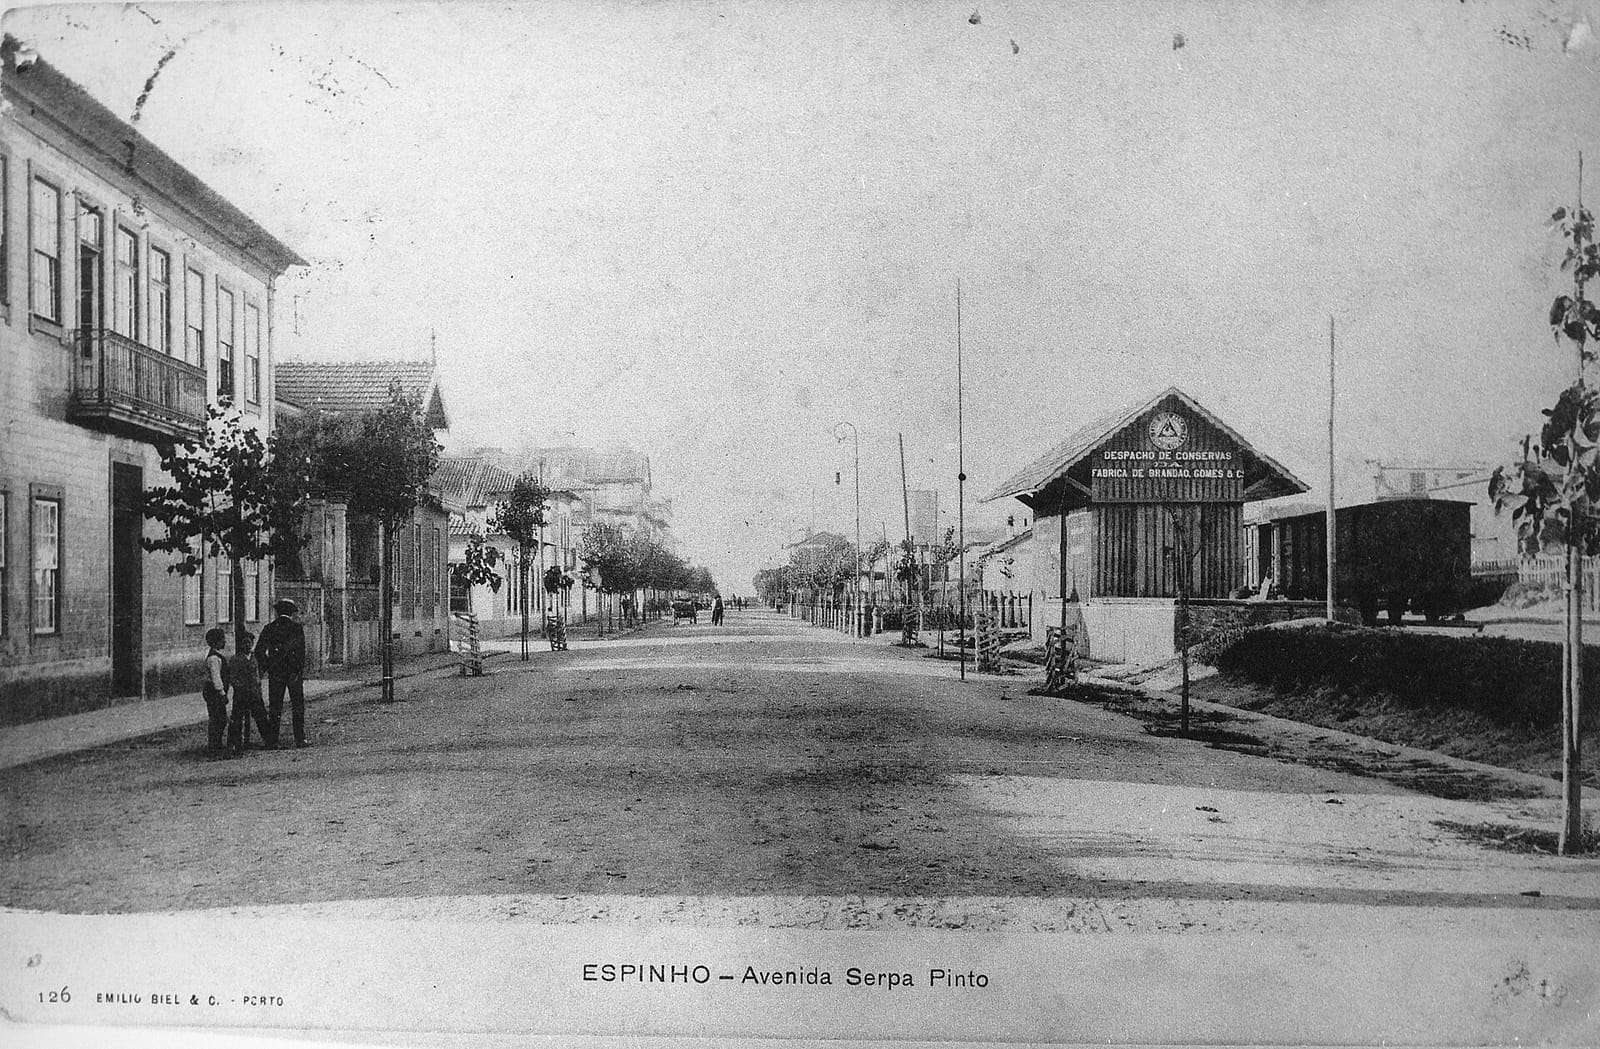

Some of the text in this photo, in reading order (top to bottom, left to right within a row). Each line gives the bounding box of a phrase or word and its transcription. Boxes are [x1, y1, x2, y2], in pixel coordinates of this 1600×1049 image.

[1104, 451, 1232, 460] DESPACHO DE CONSERVAS
[1091, 468, 1128, 478] FABRICA
[1132, 468, 1144, 478] DE
[1193, 468, 1224, 478] GOMES
